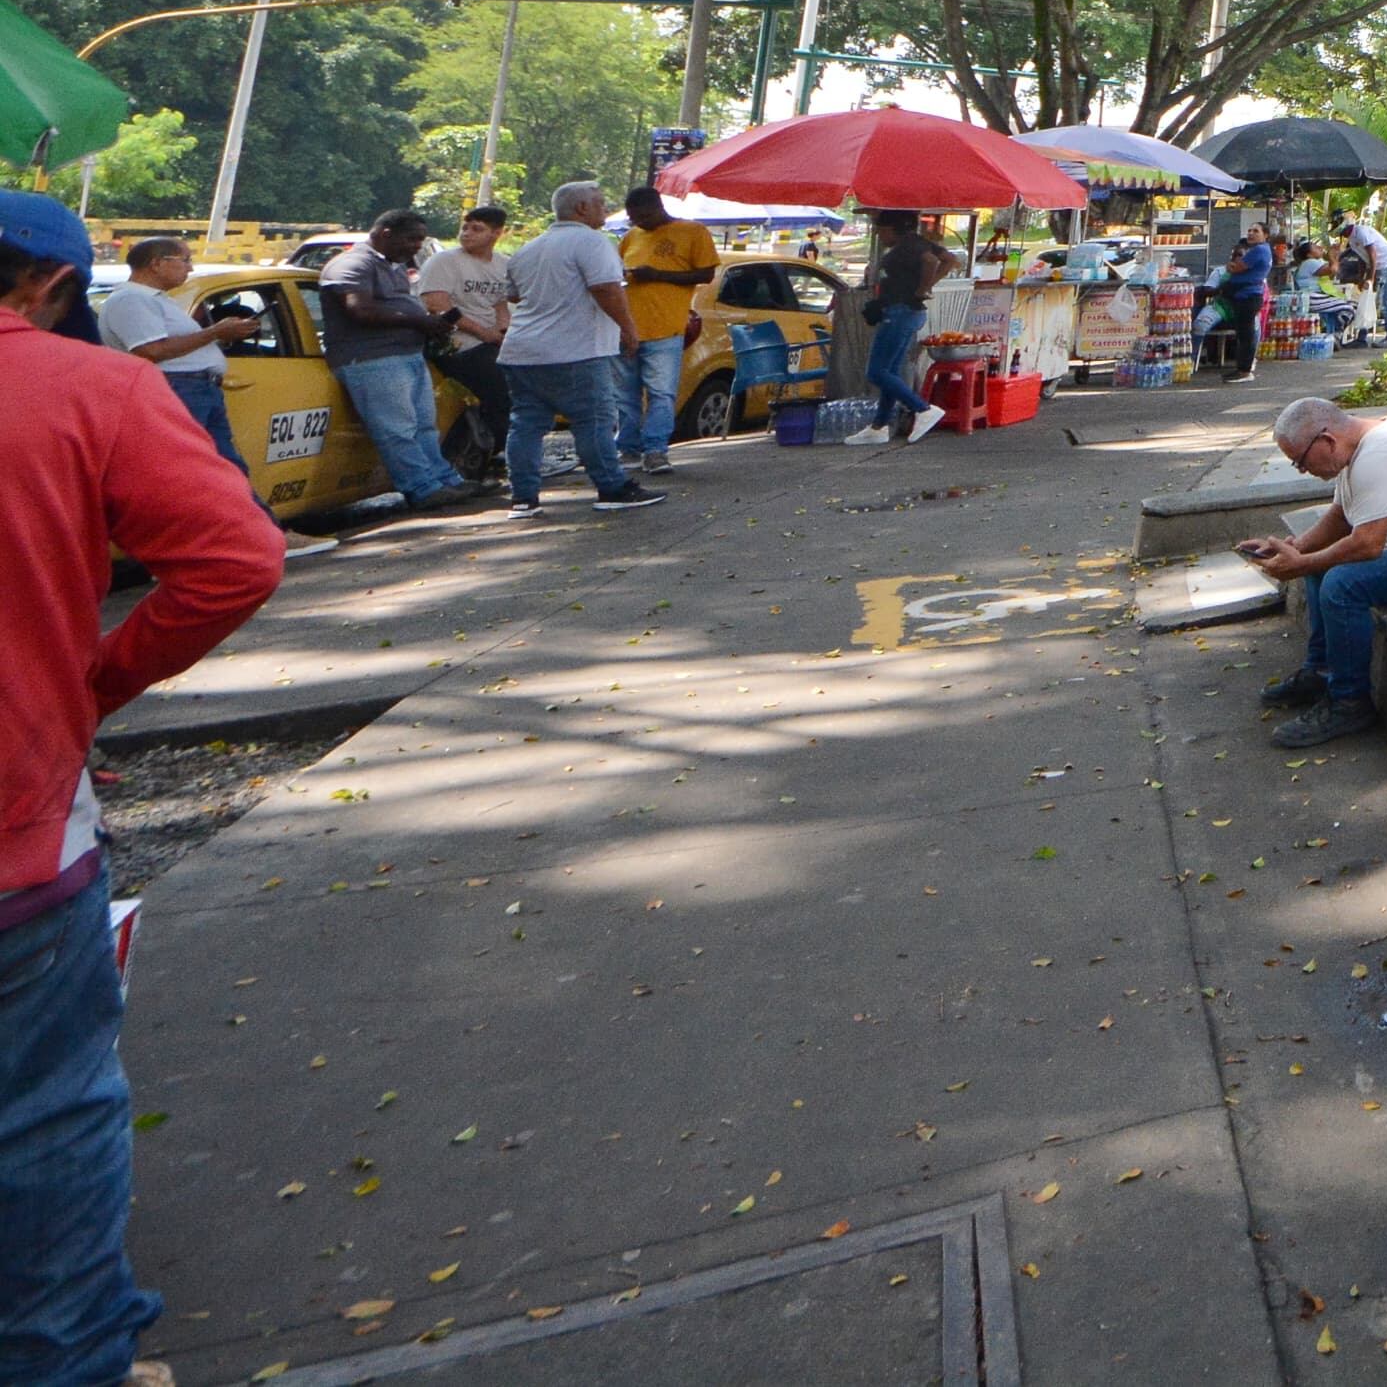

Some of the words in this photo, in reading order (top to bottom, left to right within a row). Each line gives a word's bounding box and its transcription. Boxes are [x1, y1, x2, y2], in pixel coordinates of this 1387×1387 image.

[270, 416, 295, 444] EQL
[303, 411, 329, 439] 822
[278, 447, 308, 459] CALI
